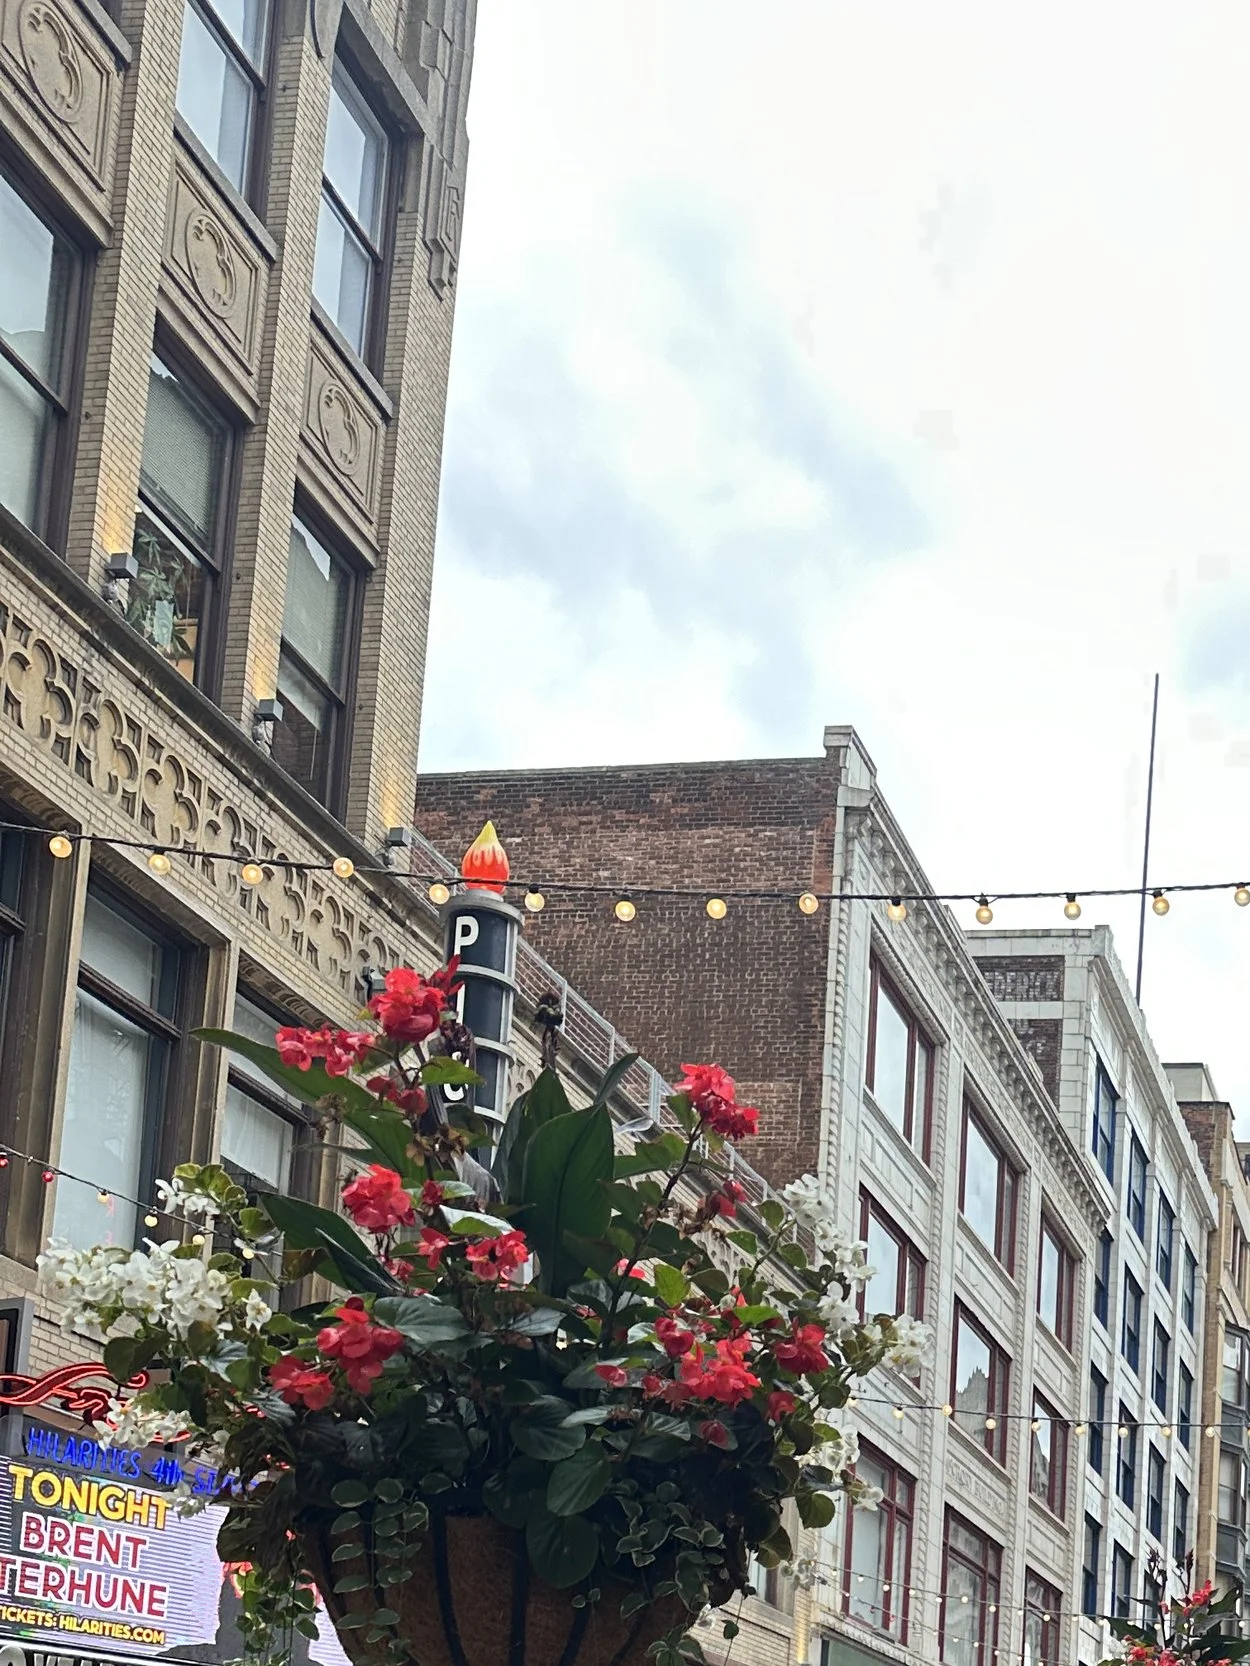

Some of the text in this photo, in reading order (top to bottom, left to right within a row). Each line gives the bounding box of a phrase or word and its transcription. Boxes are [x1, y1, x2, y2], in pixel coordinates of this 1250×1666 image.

[27, 1426, 142, 1480] HILARITIES
[8, 1464, 172, 1531] TONIGHT
[22, 1513, 149, 1571] BRENT
[0, 1605, 165, 1645] ICKETS: HILARITIES.COM
